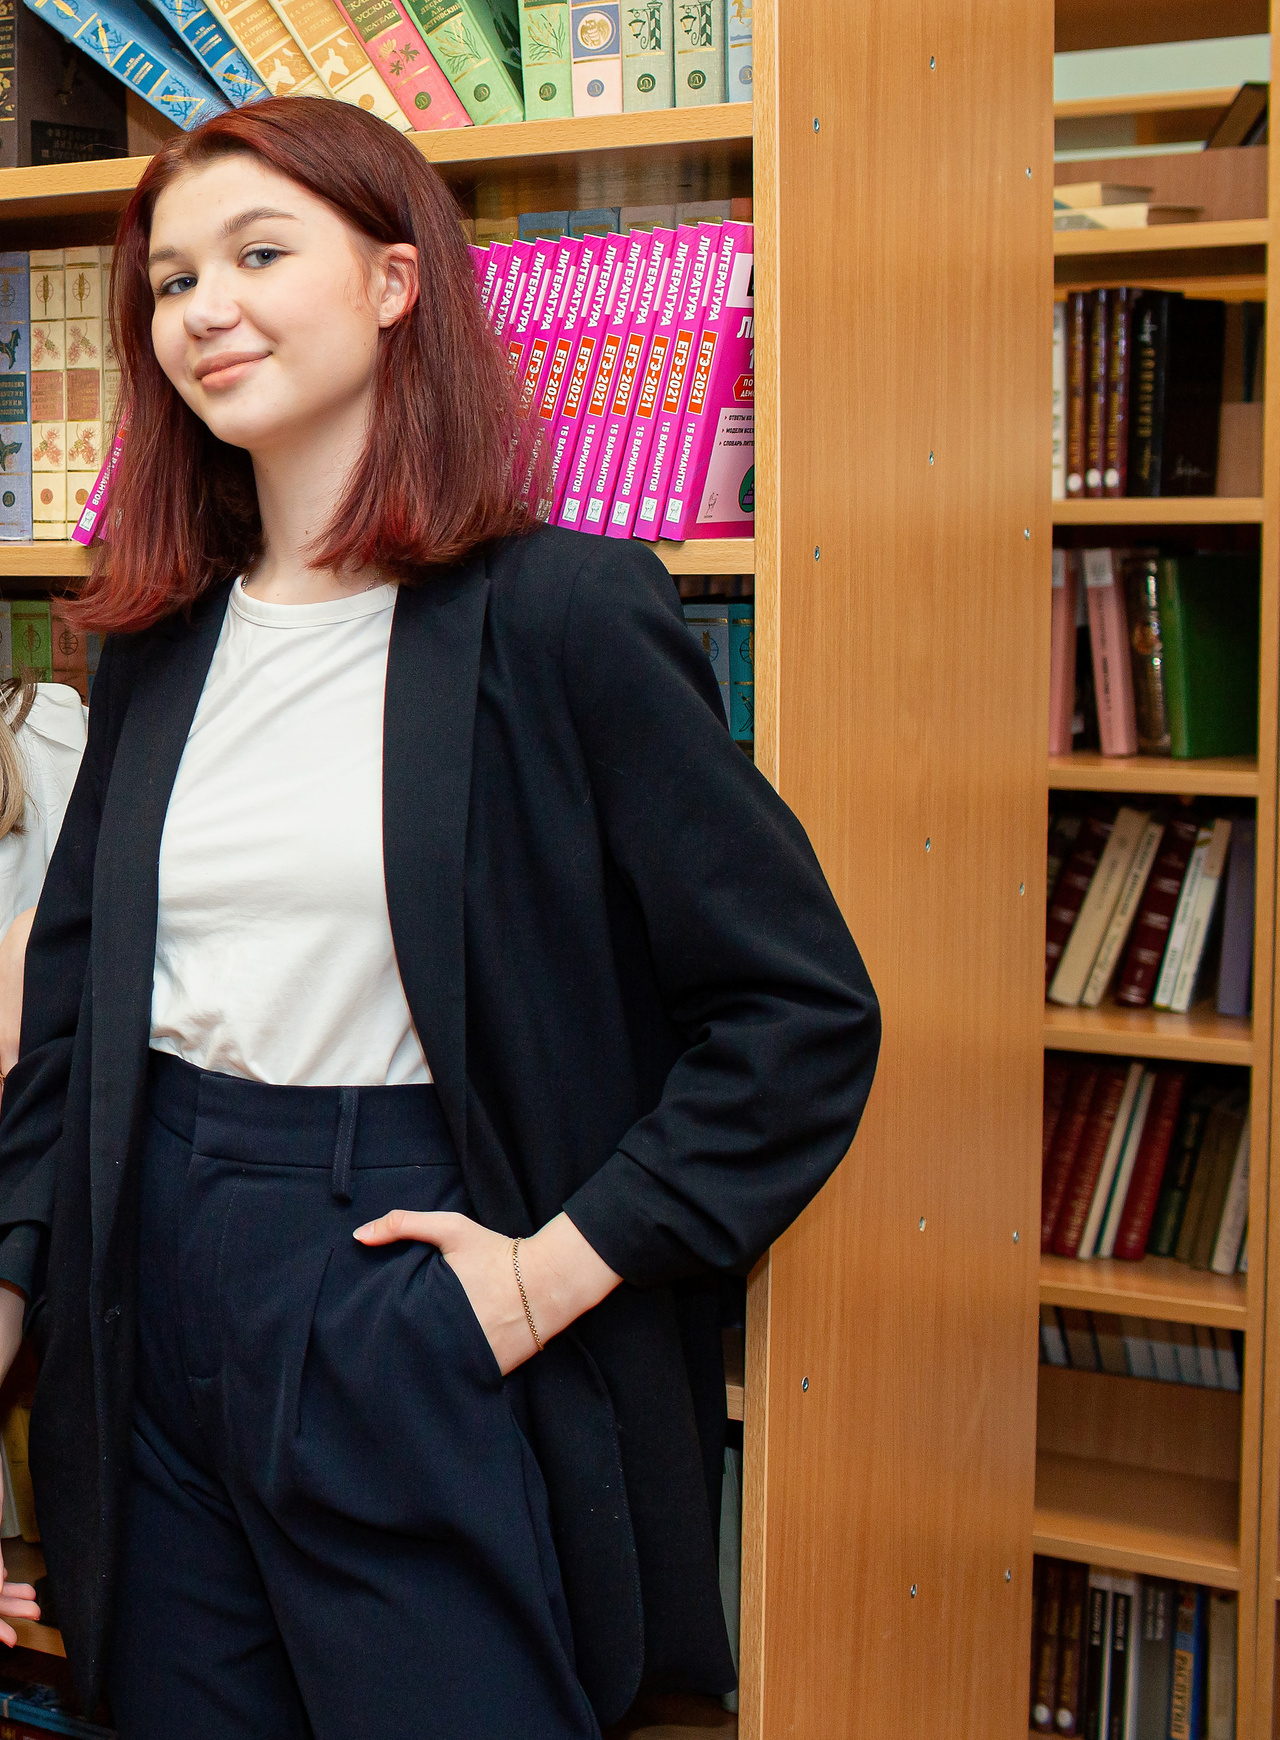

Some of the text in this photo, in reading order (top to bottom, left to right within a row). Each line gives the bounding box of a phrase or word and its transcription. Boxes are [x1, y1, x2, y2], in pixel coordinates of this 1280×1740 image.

[516, 251, 545, 333] ЛИТЕРАТУРА
[540, 248, 570, 330] ЛИТЕРАТУРА
[564, 247, 593, 330] ЛИТЕРАТУРА
[587, 245, 617, 328] ЛИТЕРАТУРА
[612, 241, 642, 326] ЛИТЕРАТУРА
[635, 240, 665, 325] ЛИТЕРАТУРА
[660, 241, 689, 327] ЛИТЕРАТУРА
[683, 235, 711, 321] ЛИТЕРАТУРА
[708, 235, 735, 322] ЛИТЕРАТУРА
[543, 349, 567, 410] ЕГЭ-2021
[567, 346, 591, 408] ЕГЭ-2021
[592, 344, 617, 407] ЕГЭ-2021
[616, 343, 640, 406] ЕГЭ-2021
[641, 345, 665, 409] ЕГЭ-2021
[666, 340, 689, 403] ЕГЭ-2021
[691, 341, 714, 405] ЕГЭ-2021
[560, 425, 570, 437] 15
[572, 423, 596, 493] 15 ВАРИАНТОВ
[595, 423, 619, 493] 15 ВАРИАНТОВ
[621, 425, 645, 496] 15 ВАРИАНТОВ
[649, 421, 670, 492] 15 ВАРИАНТОВ
[674, 422, 696, 493] 15 ВАРИАНТОВ
